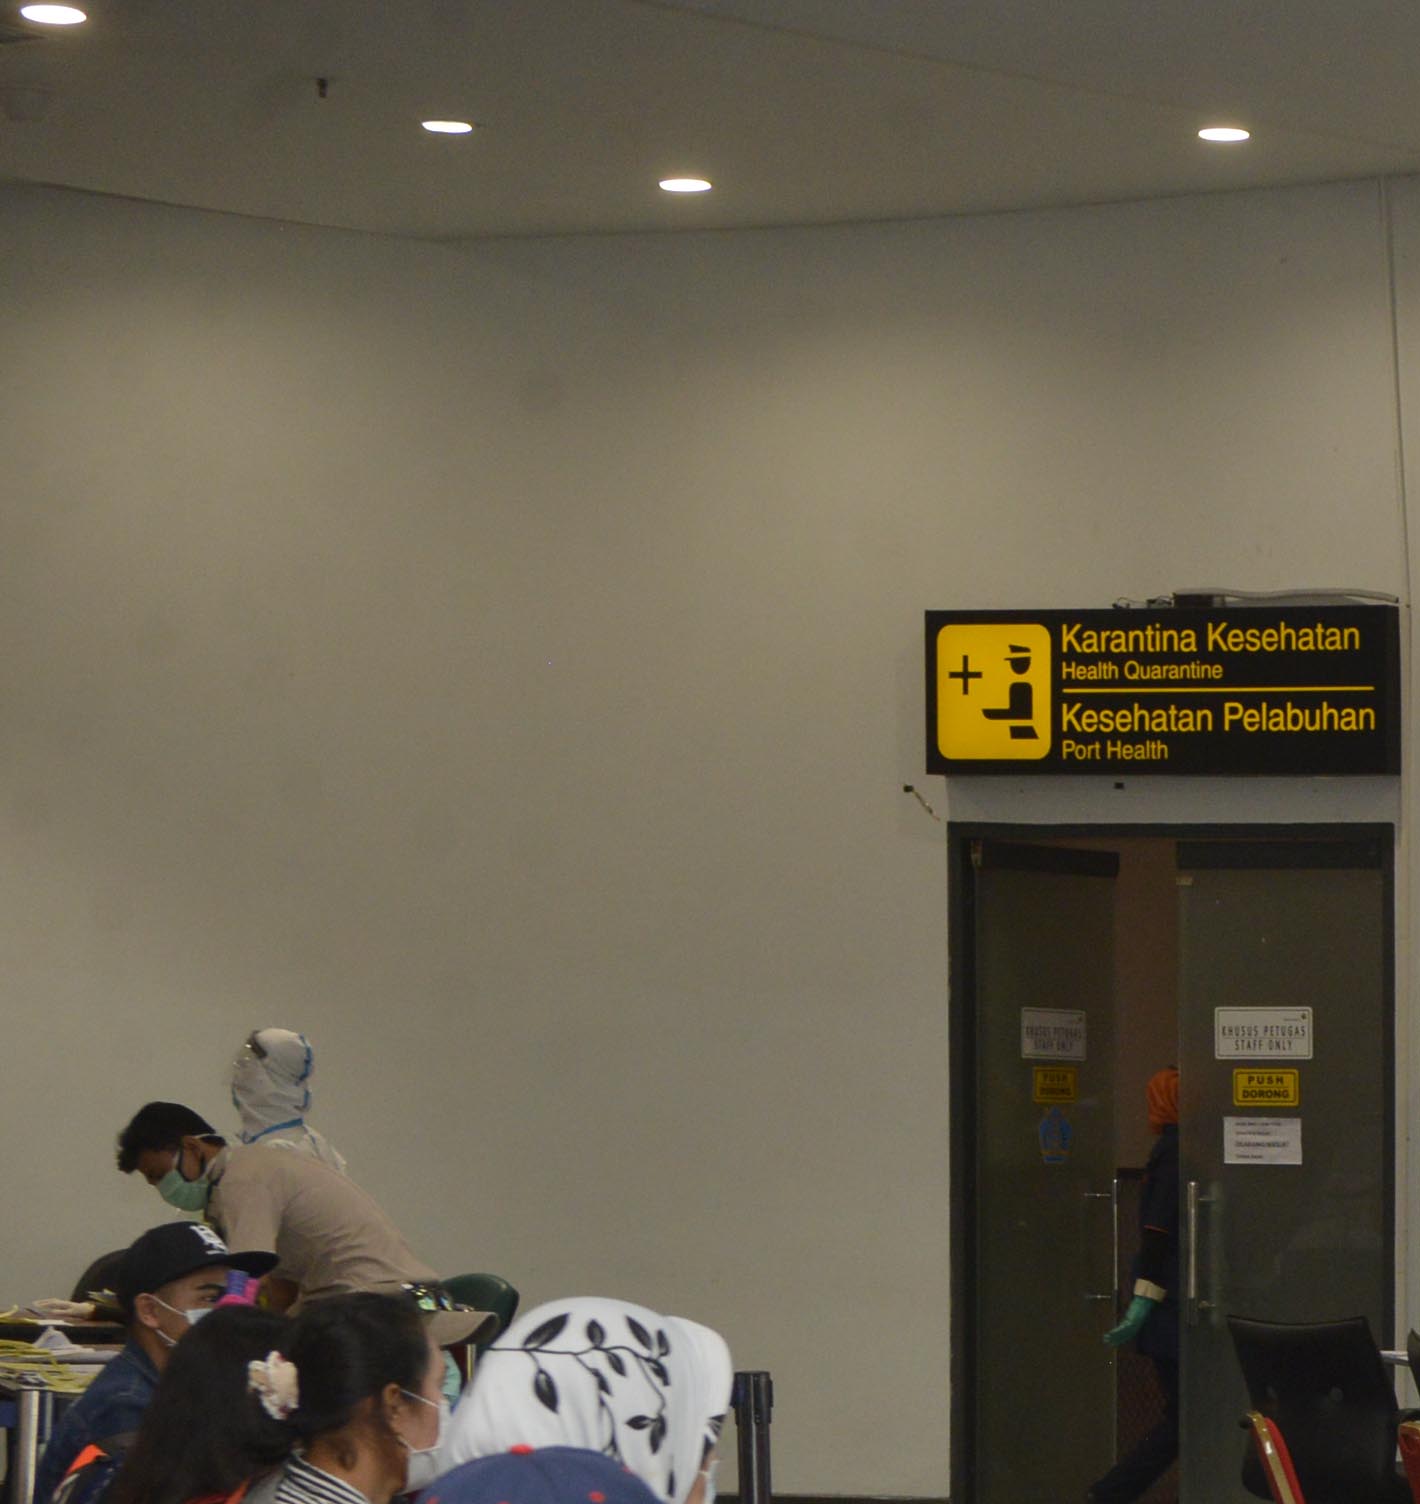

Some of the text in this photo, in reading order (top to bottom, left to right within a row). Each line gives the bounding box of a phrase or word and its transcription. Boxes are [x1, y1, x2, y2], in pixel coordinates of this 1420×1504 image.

[1061, 621, 1361, 653] Karantina Kesehatan
[1061, 660, 1224, 680] Health Quarantine
[1061, 701, 1376, 732] Kesehatan Pelabuhan
[1061, 739, 1169, 760] Port Health
[1222, 1025, 1306, 1037] KHUSUS PETUGAS
[1234, 1039, 1293, 1051] STAFF ONLY
[1247, 1075, 1284, 1085] PUSH
[1242, 1088, 1289, 1099] DORONG
